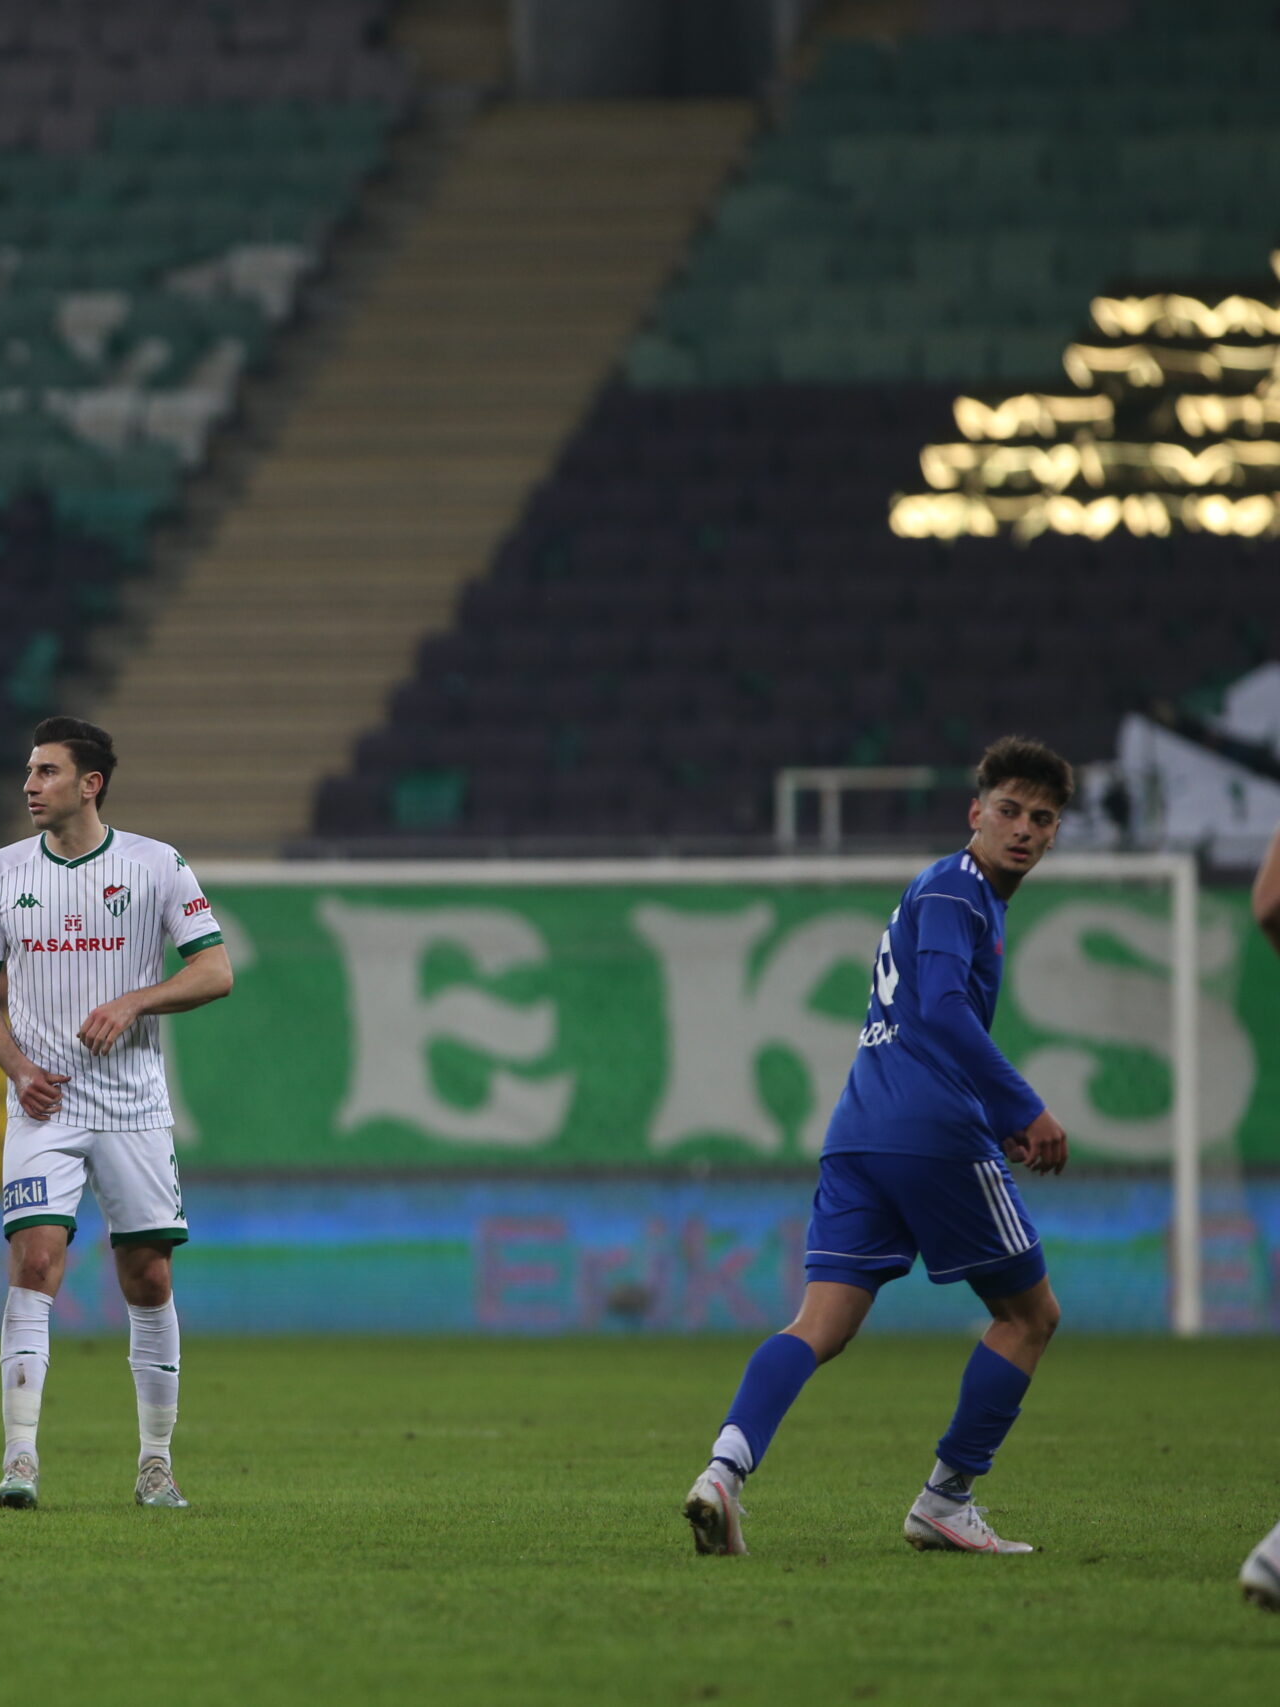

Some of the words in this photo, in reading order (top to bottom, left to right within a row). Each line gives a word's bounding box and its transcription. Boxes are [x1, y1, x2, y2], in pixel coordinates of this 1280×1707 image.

[22, 937, 125, 952] TASARRUF
[160, 895, 1255, 1156] EKS
[4, 1180, 43, 1209] Erikli
